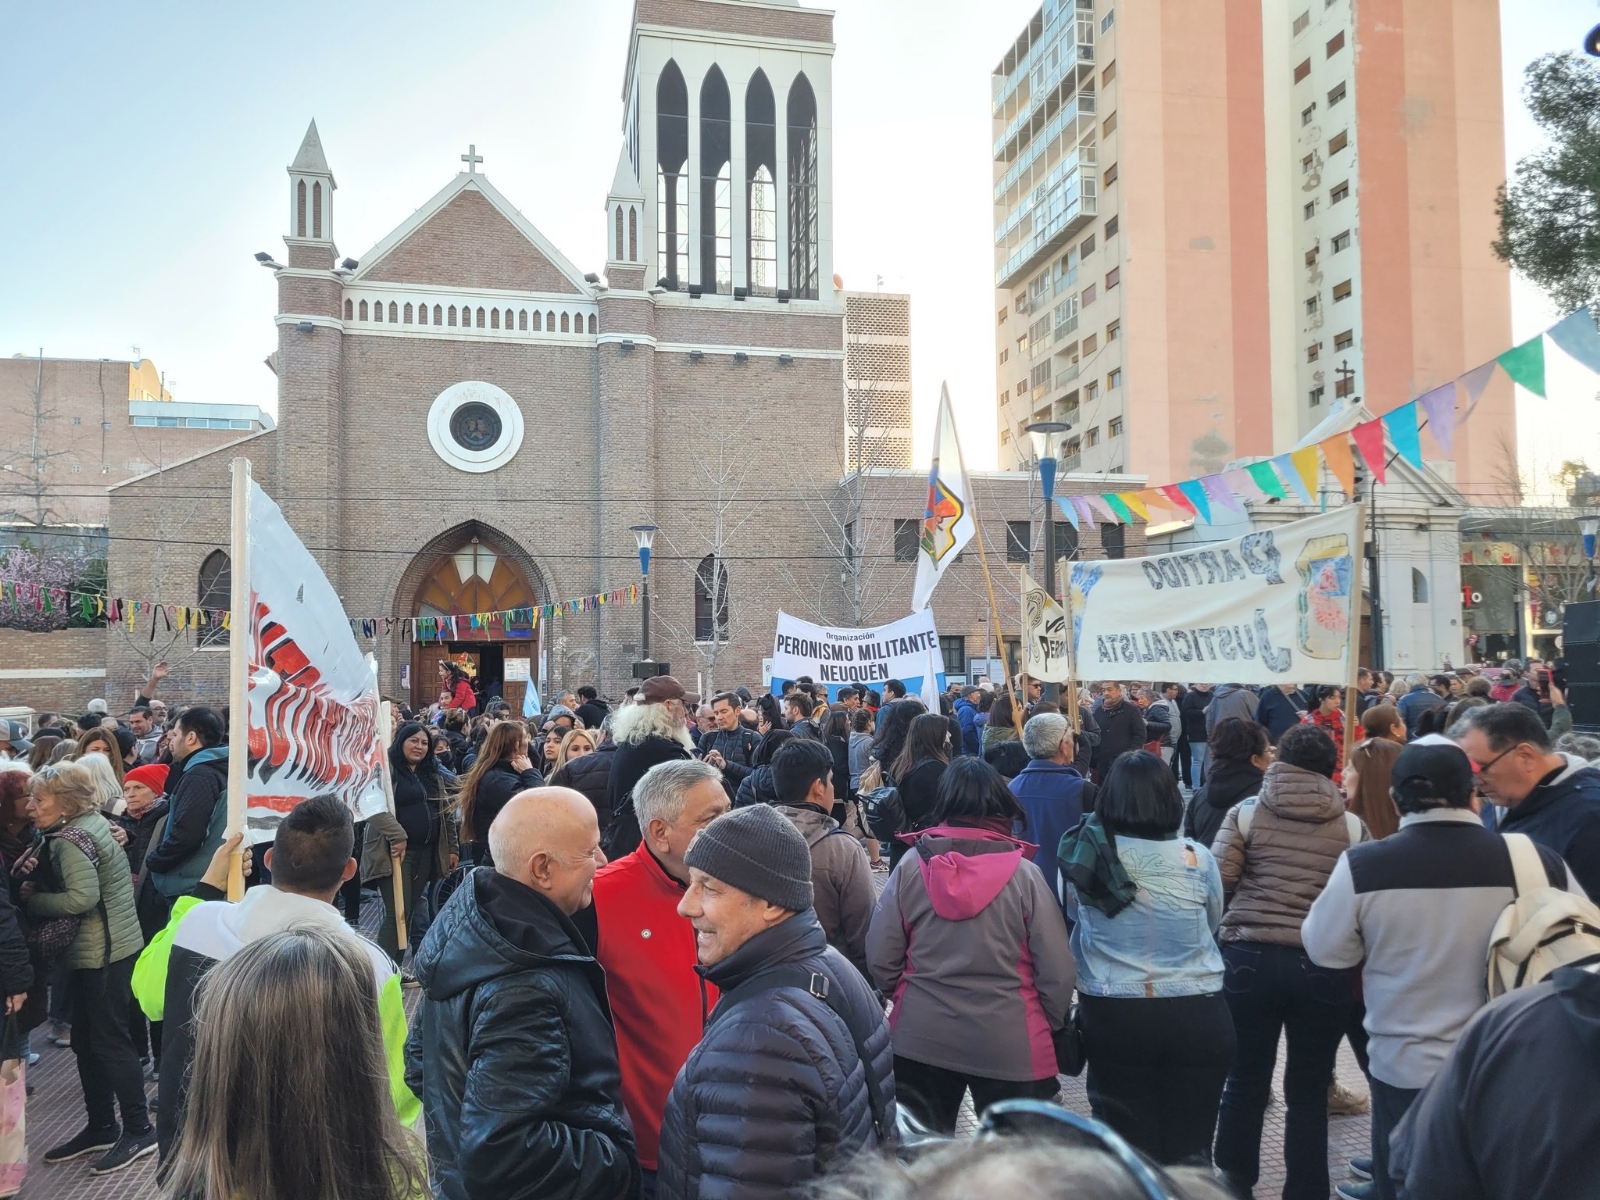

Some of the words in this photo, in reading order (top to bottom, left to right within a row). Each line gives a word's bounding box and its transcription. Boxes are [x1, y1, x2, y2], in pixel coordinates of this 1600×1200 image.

[777, 634, 854, 661] PERONISMO
[858, 630, 937, 661] MILITANTE
[826, 632, 875, 642] Organización
[820, 662, 889, 682] NEUQUÉN
